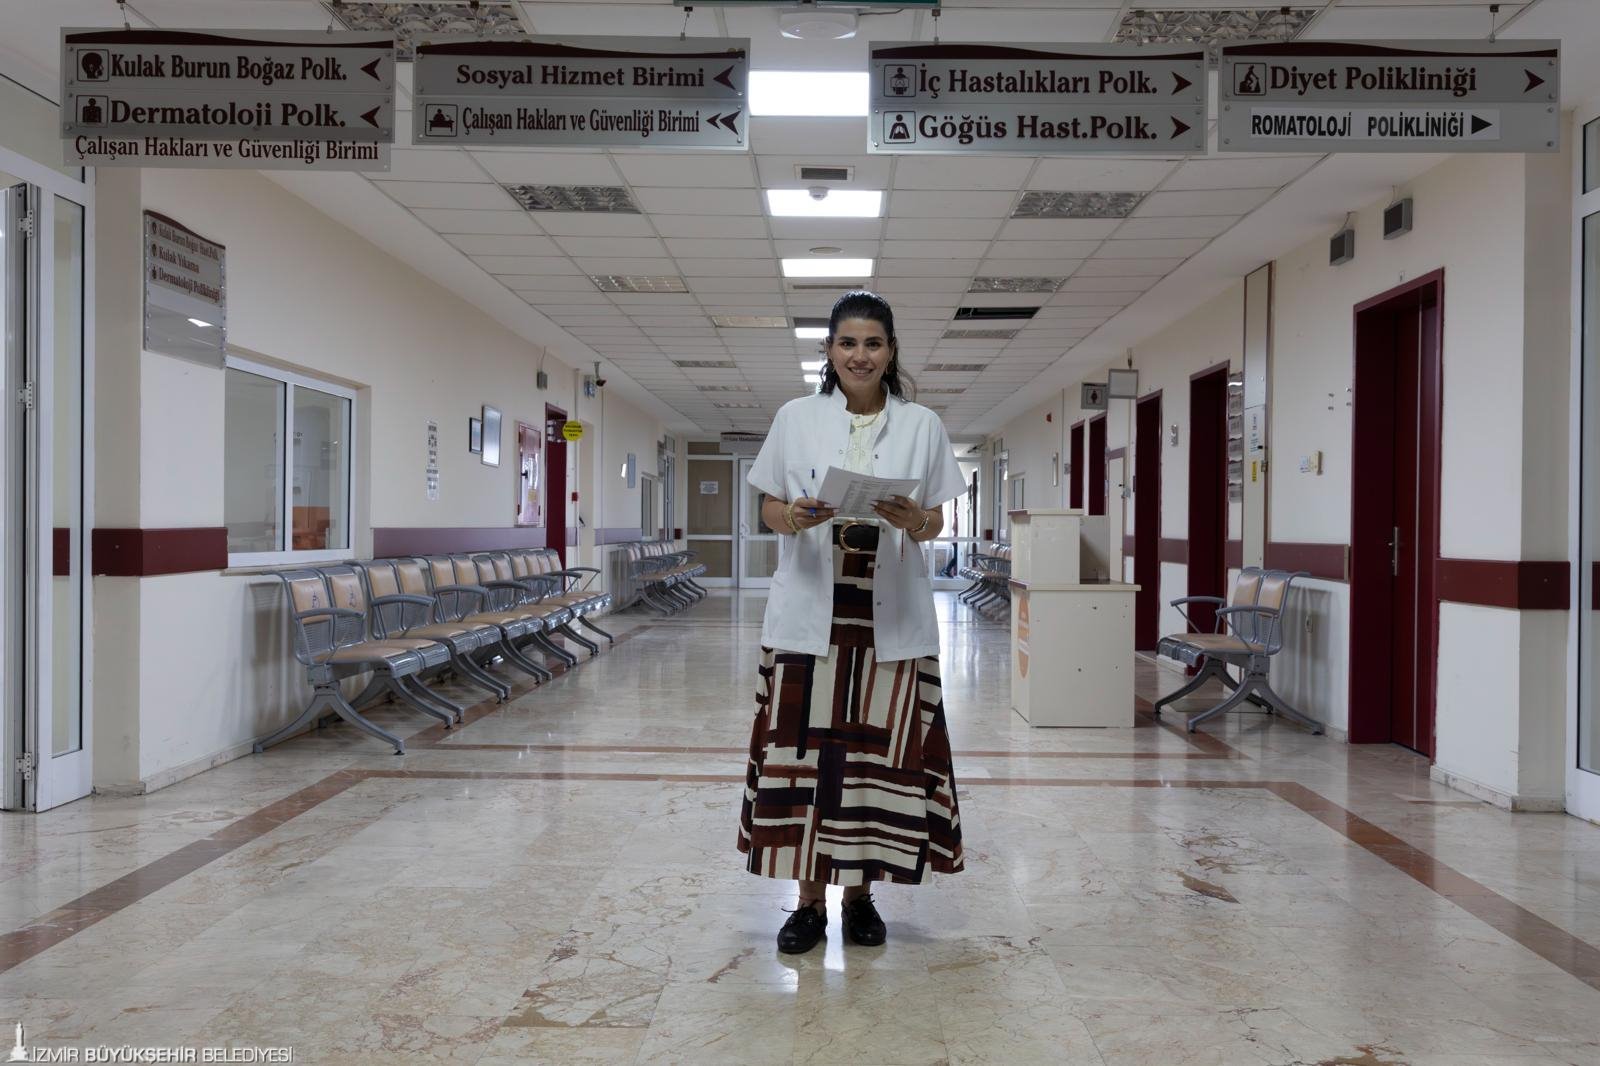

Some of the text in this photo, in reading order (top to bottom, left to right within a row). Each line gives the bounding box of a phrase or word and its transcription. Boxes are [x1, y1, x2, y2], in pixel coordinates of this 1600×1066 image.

[111, 54, 347, 86] Kulak Burun Boğaz Polk.
[457, 64, 705, 89] Sosyal Hizmet Birimi
[919, 63, 1158, 99] İç Hastalıkları Polk.
[1270, 66, 1477, 97] Diyet Polikliniği
[110, 100, 346, 129] Dermatoloji Polk.
[462, 107, 700, 137] Çalışan Hakları ve Güvenliği Birimi
[919, 114, 1158, 144] Göğüs Hast.Polk.
[1252, 111, 1464, 138] ROMATOLOJİ POLİKLİNİĞİ
[75, 135, 379, 164] Çalışan Hakları ve Güvenliği Birimi
[158, 247, 177, 265] Kulak
[158, 267, 193, 295] Dermatoloji
